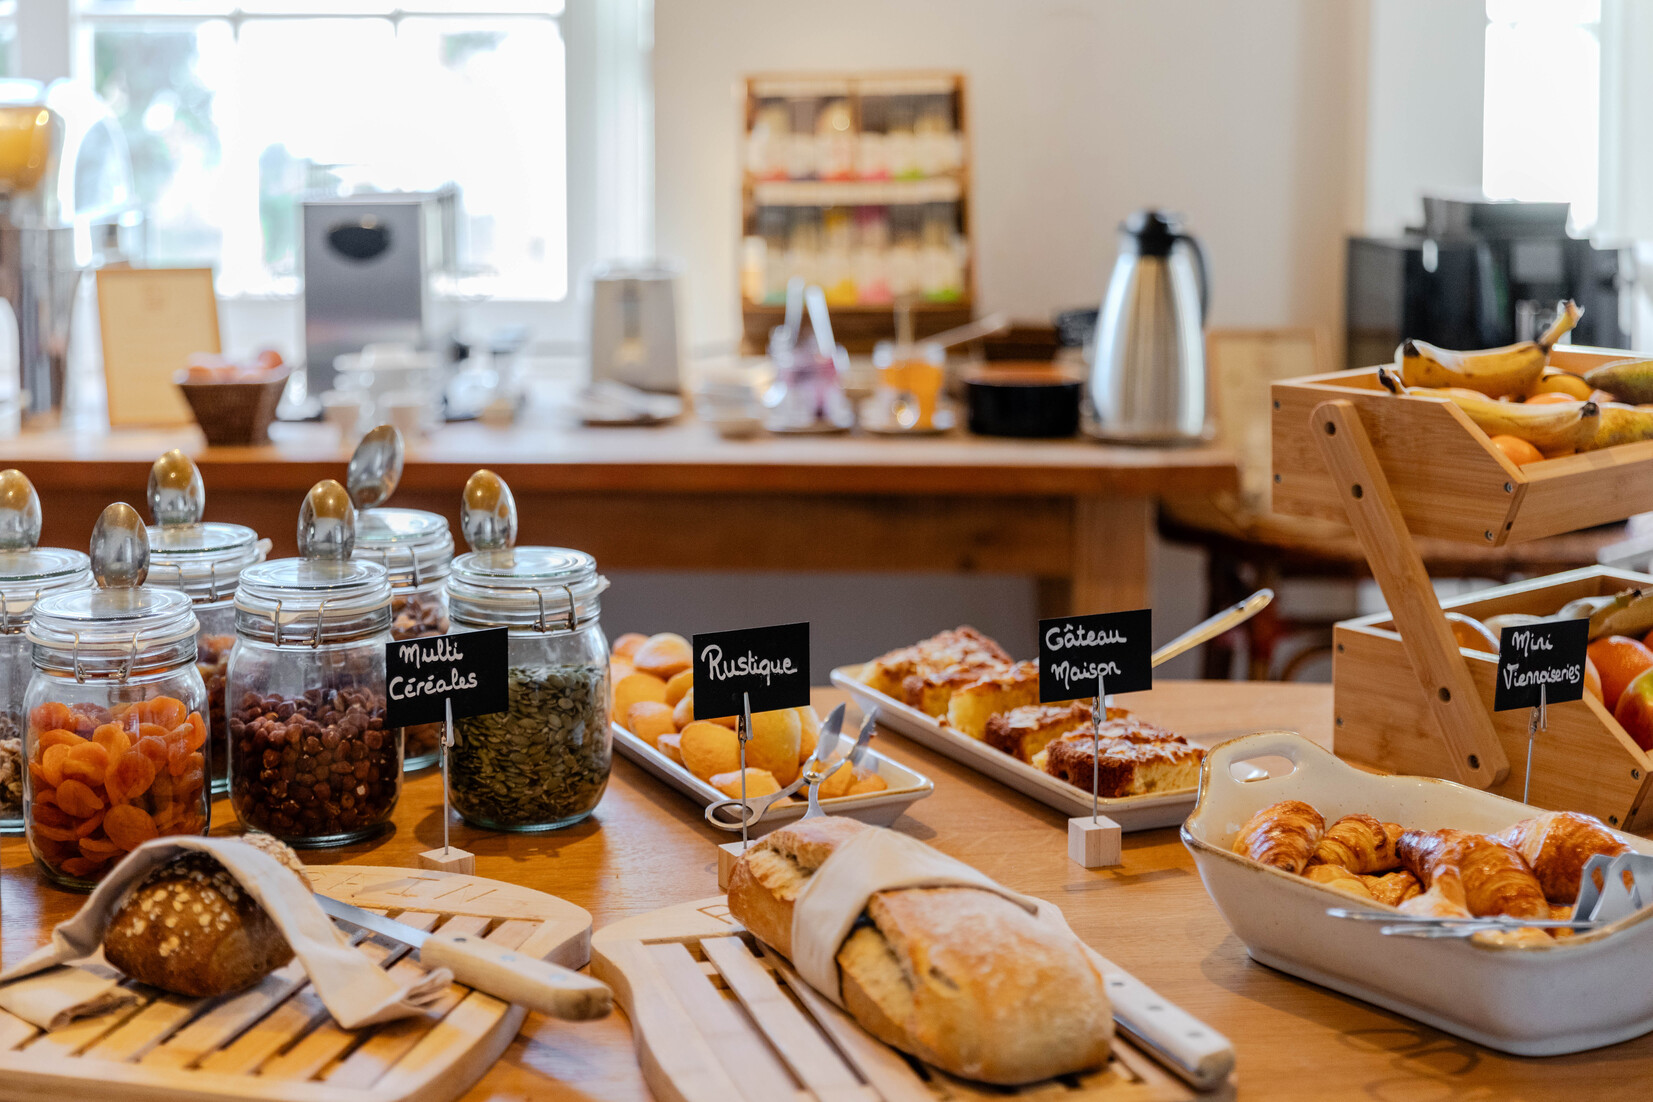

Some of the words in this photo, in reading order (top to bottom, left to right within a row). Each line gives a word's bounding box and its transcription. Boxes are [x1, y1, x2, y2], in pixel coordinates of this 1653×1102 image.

[1045, 623, 1127, 651] Gâteau
[1511, 630, 1553, 657] Mini
[399, 638, 463, 669] Multi
[701, 644, 798, 686] Rustique
[389, 667, 478, 700] Céréales
[1051, 660, 1121, 690] Maison
[1503, 663, 1580, 690] Viennoiseries
